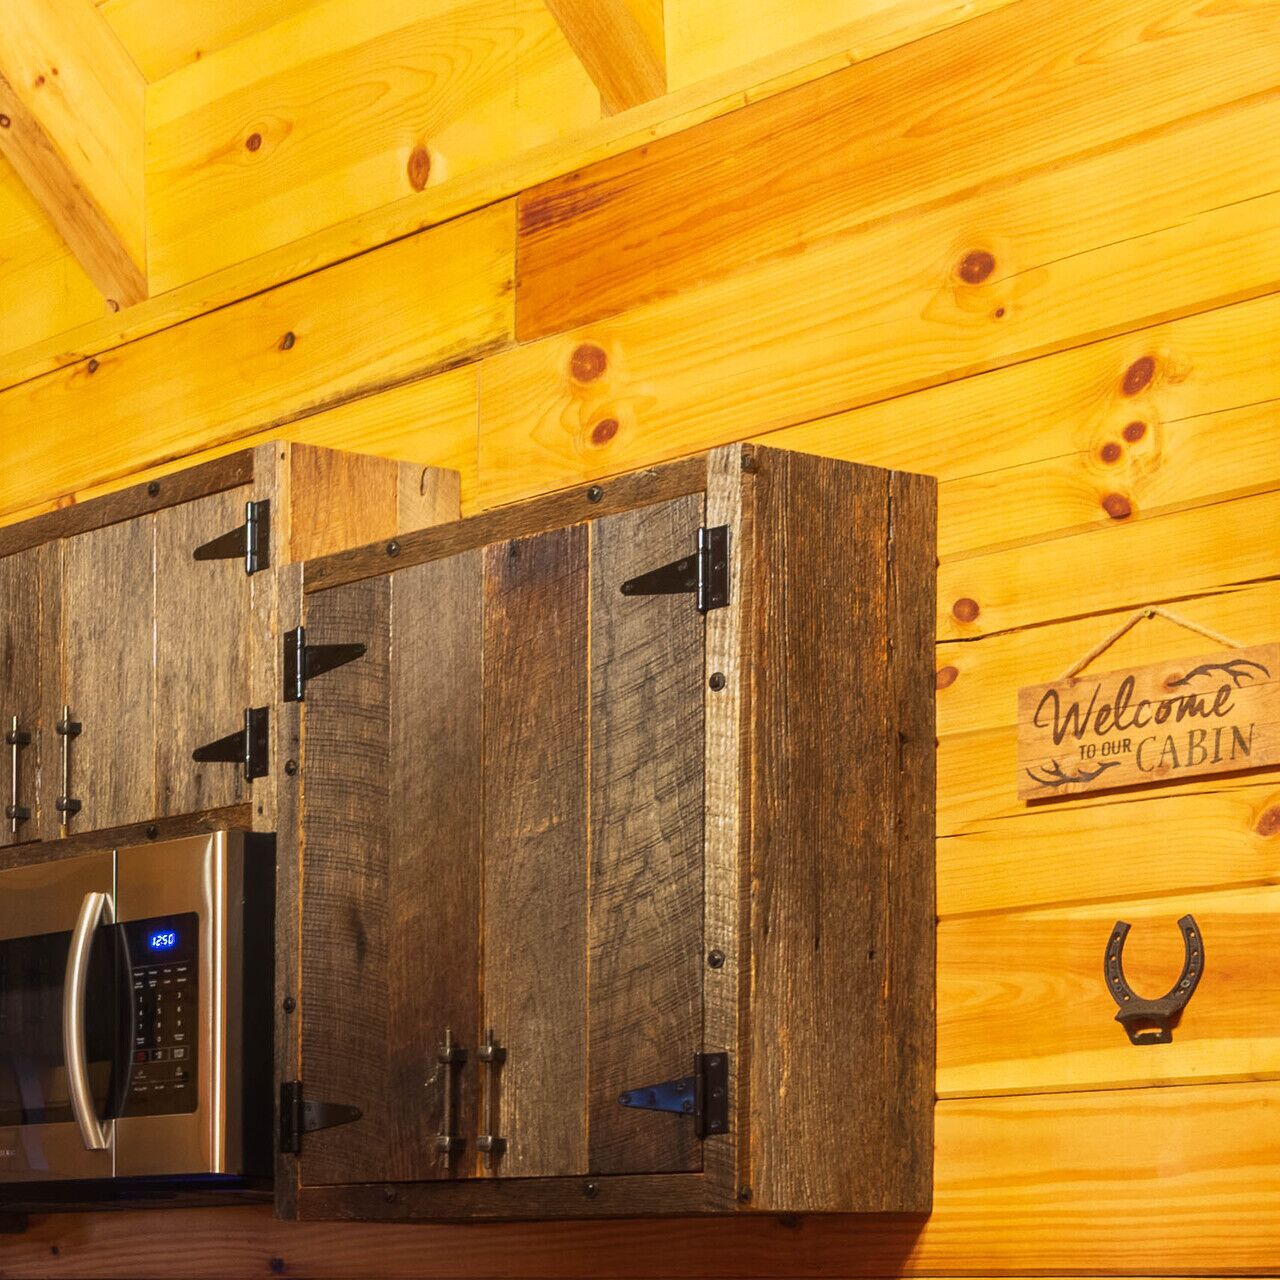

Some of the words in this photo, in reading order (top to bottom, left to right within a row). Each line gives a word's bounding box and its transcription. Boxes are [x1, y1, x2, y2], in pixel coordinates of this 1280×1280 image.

[1033, 674, 1235, 746] Welcome
[1079, 743, 1096, 760] TO
[1101, 737, 1132, 757] OUR
[1135, 722, 1256, 773] CABIN
